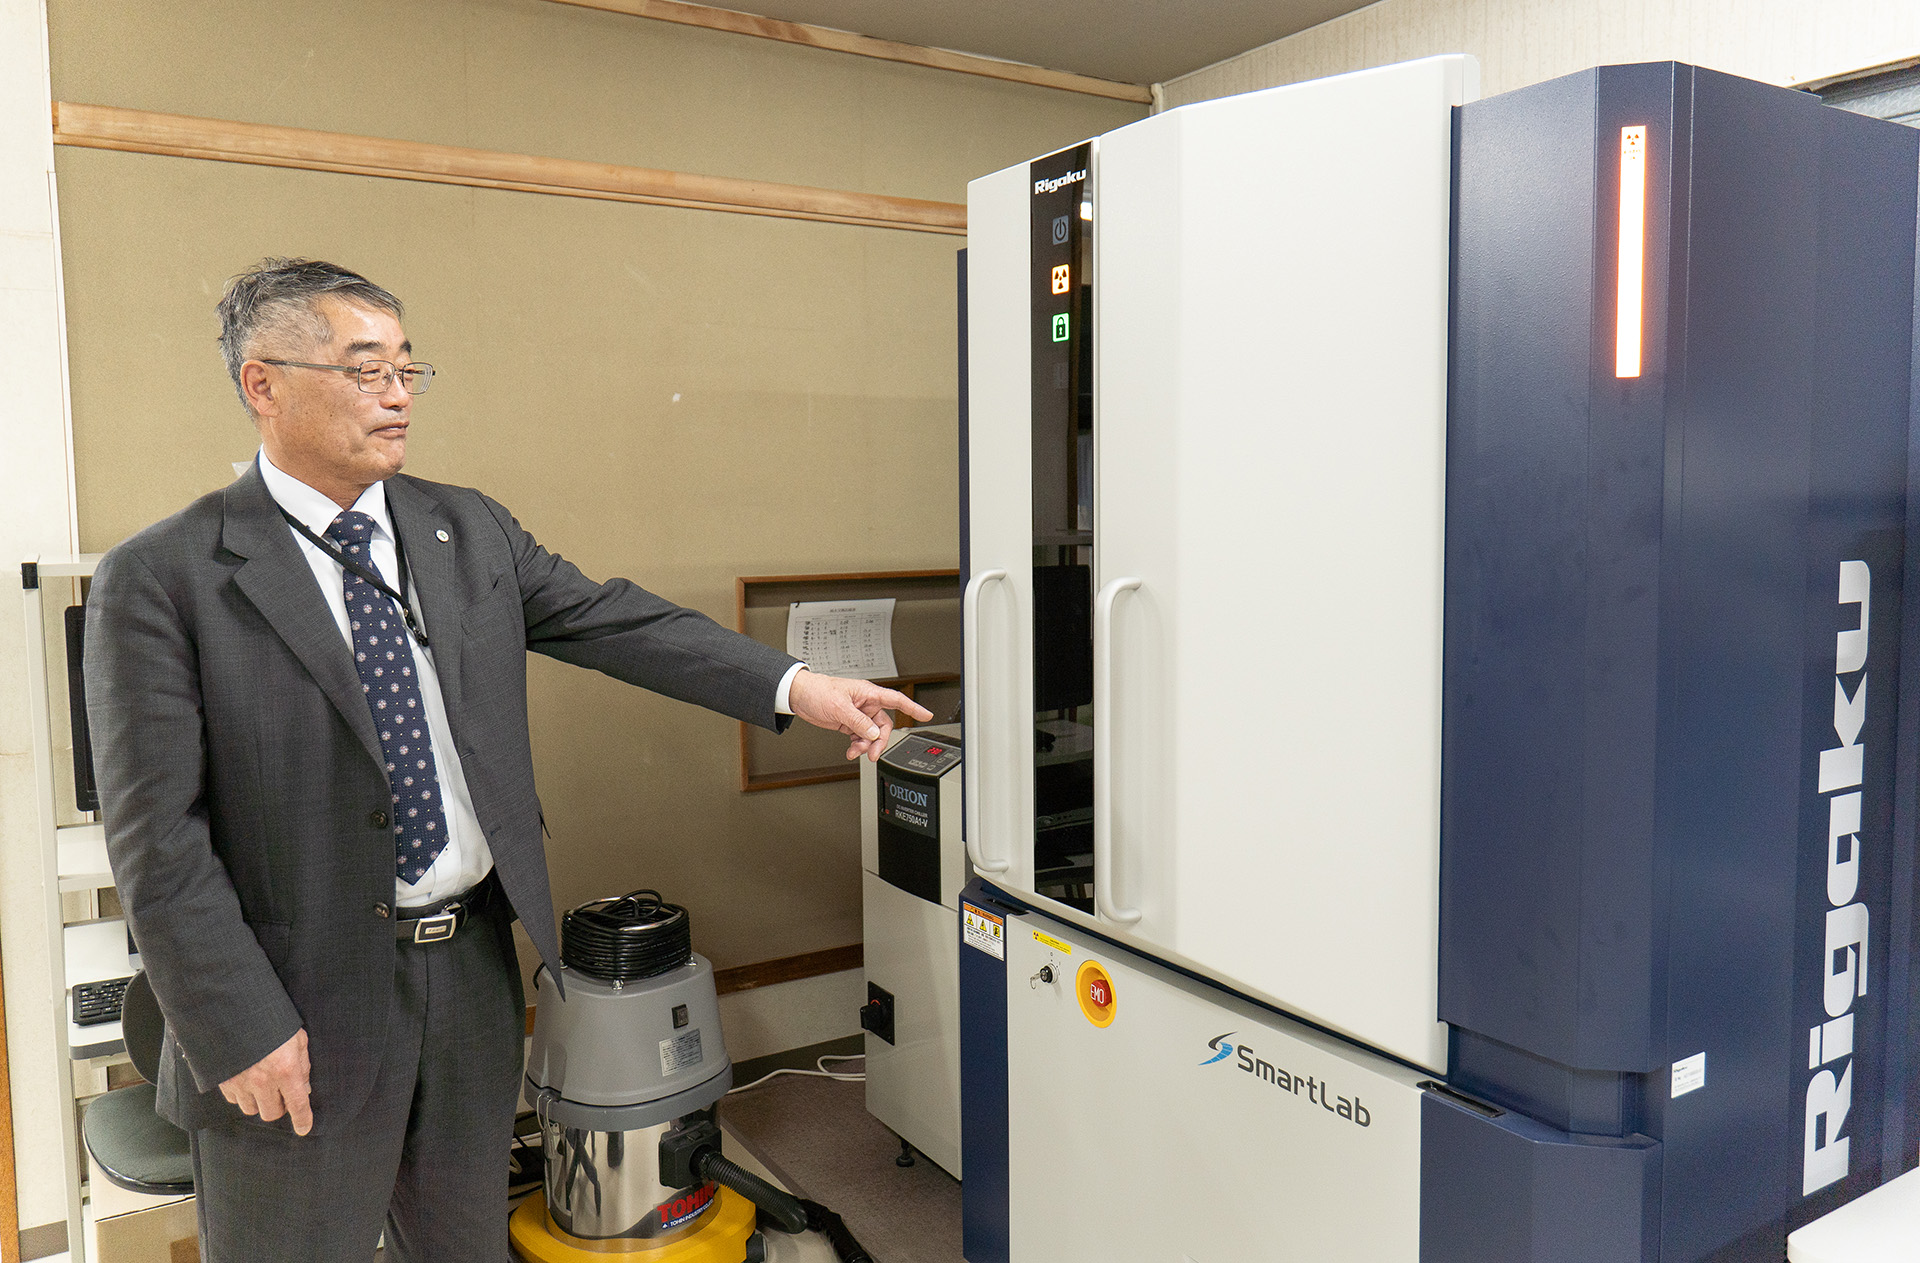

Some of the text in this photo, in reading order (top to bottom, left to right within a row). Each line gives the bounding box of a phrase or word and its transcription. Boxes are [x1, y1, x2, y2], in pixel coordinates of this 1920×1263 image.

[1035, 169, 1086, 194] Rigaku
[889, 784, 928, 807] ORION
[1803, 560, 1870, 1197] Rigaku
[1090, 983, 1104, 1004] EMO
[1237, 1044, 1371, 1127] SmartLab
[657, 1181, 714, 1223] TOHIN
[670, 1217, 685, 1227] TOHIN
